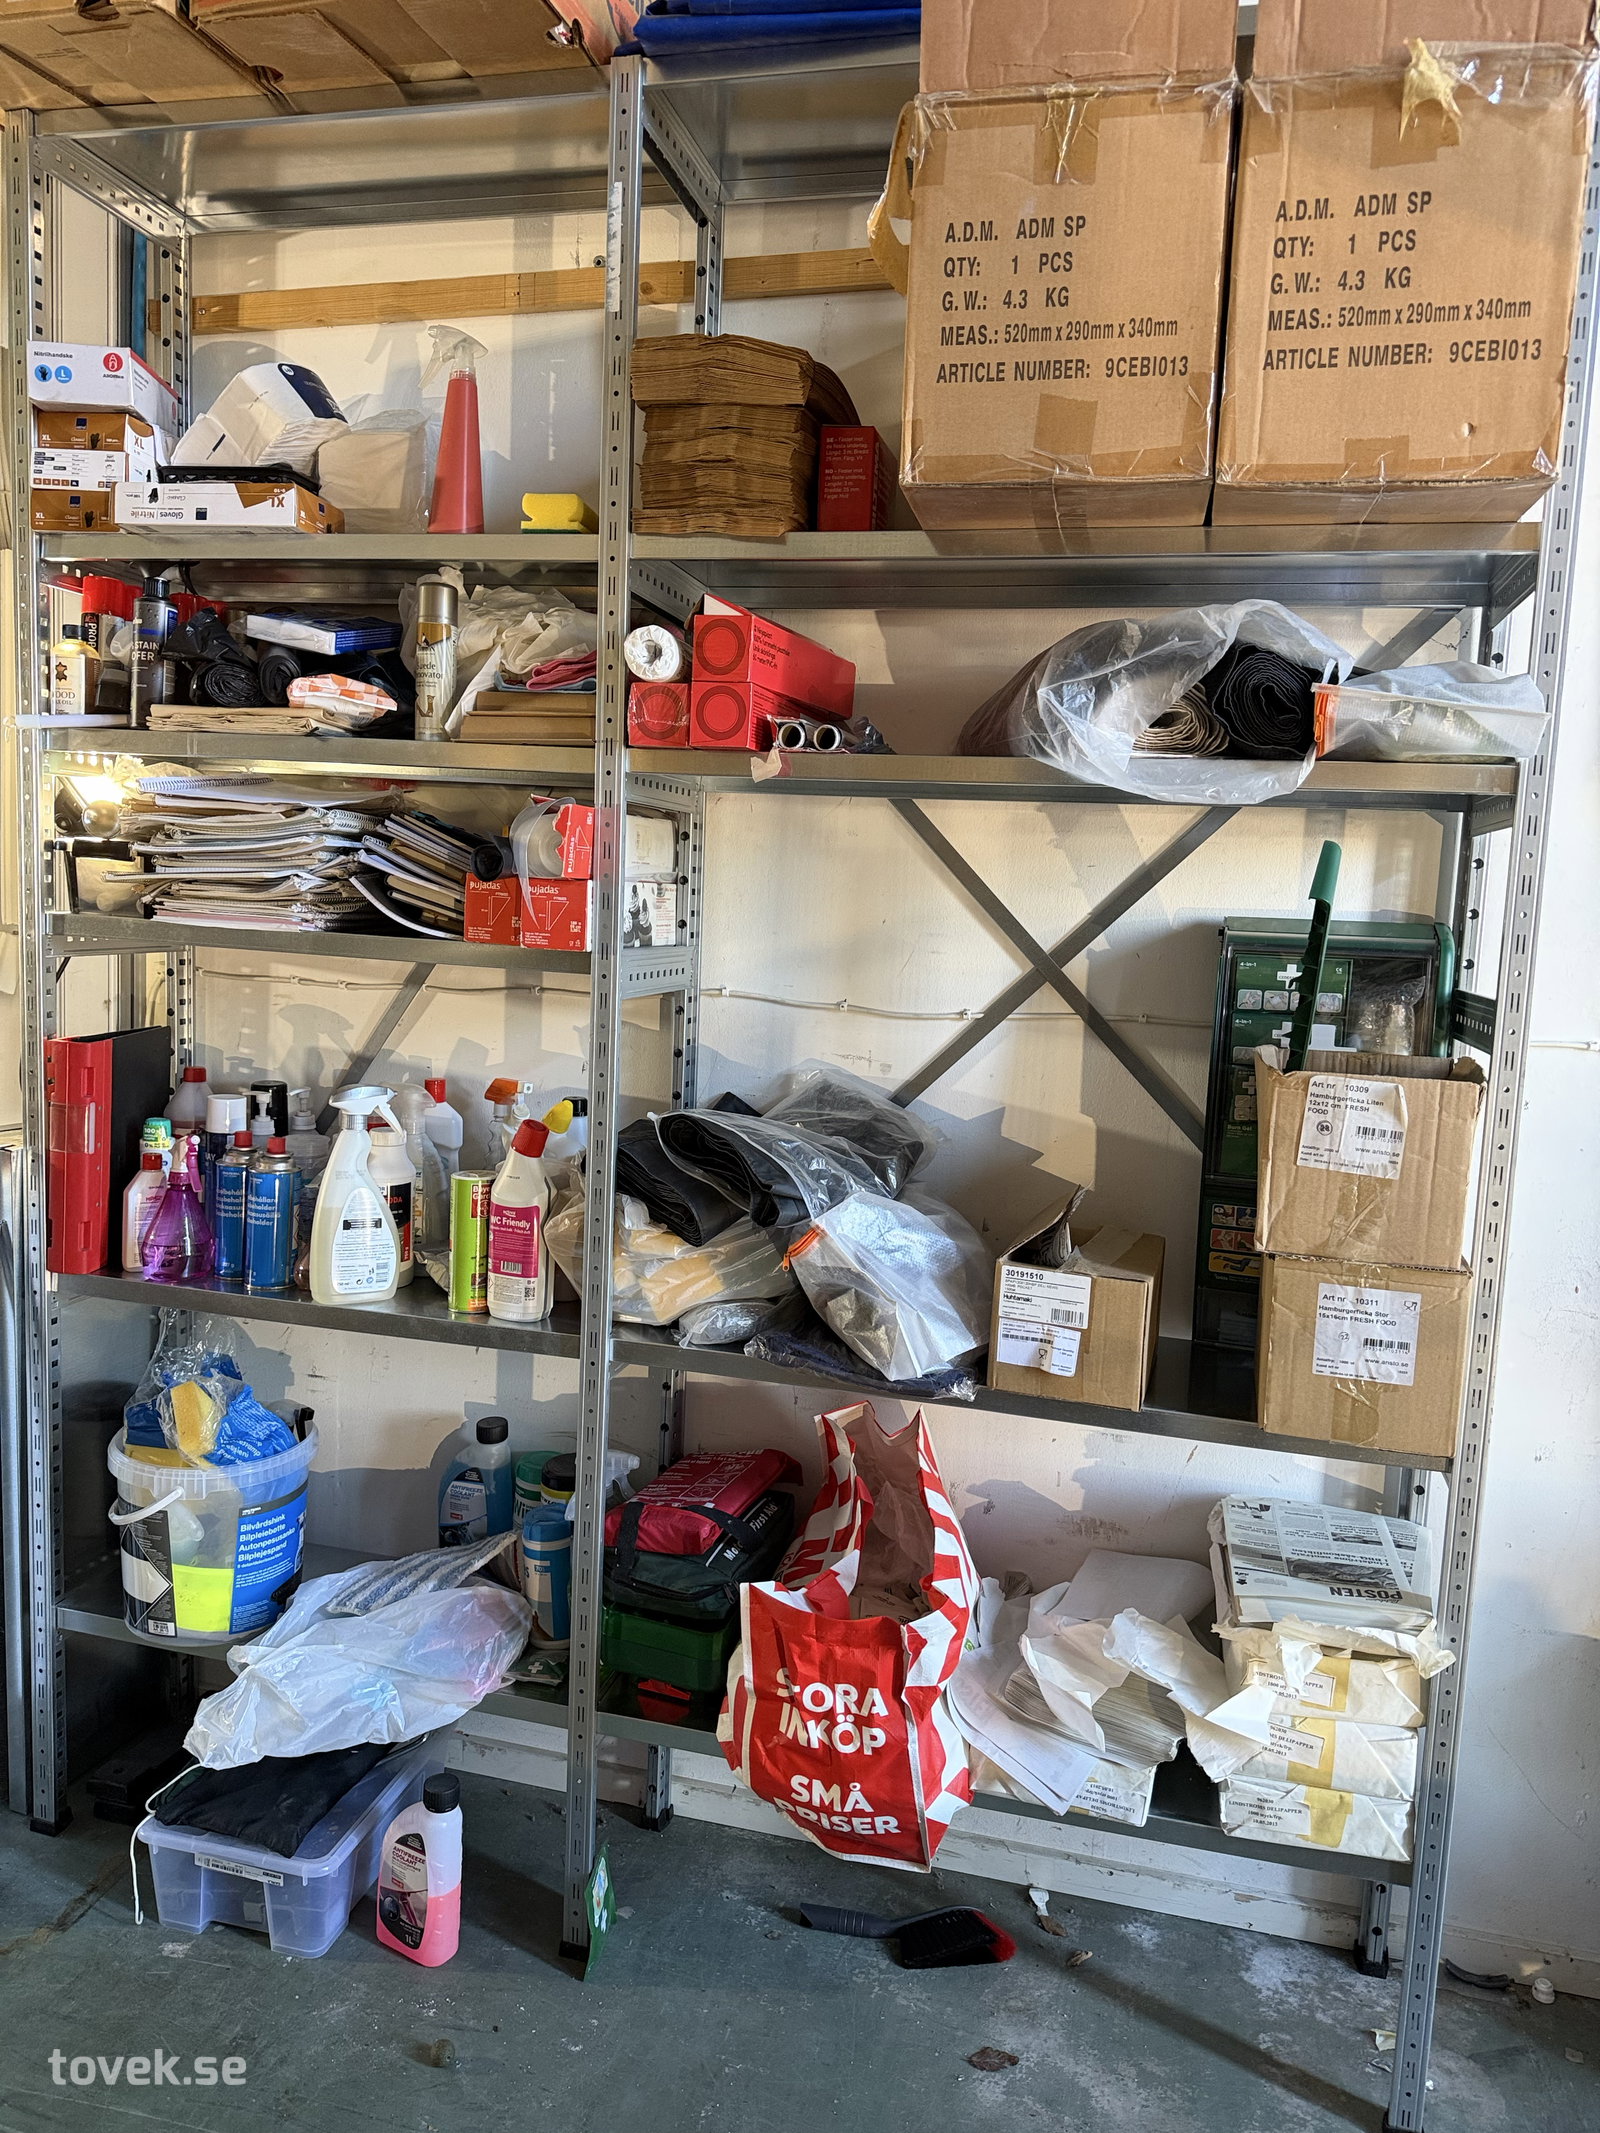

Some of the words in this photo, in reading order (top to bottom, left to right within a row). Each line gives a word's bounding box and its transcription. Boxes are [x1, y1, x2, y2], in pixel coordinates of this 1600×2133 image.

[1275, 197, 1335, 223] A.D.M.
[1353, 193, 1397, 217] ADM
[1407, 190, 1432, 214] SP
[945, 220, 998, 243] A.D.M.
[1016, 217, 1055, 240] ADM
[1063, 215, 1087, 237] SP
[1273, 235, 1314, 259] QTY:
[1348, 233, 1356, 255] 1
[1377, 228, 1417, 252] PCS
[943, 256, 981, 278] QTY:
[1011, 255, 1018, 275] 1
[1038, 251, 1073, 274] PCS
[1337, 269, 1365, 291] 4.3
[1384, 266, 1412, 289] KG
[1003, 289, 1028, 310] 4.3
[1045, 286, 1070, 308] KG
[1268, 307, 1332, 332] MEAS.:
[1338, 305, 1390, 328] 520mm
[1394, 308, 1403, 324] x
[1406, 301, 1460, 324] 290mm
[1463, 304, 1472, 321] x
[1475, 297, 1531, 320] 340mm
[940, 324, 998, 346] MEAS.:
[1004, 323, 1051, 343] 520mm
[1055, 327, 1062, 341] x
[1066, 319, 1114, 341] 290mm
[1118, 323, 1125, 338] x
[1128, 316, 1178, 338] 340mm
[33, 351, 74, 359] Nitrilhandske
[1263, 346, 1339, 370] ARTICLE
[1348, 343, 1432, 367] NUMBER:
[1449, 338, 1542, 363] 9CEBI013
[936, 361, 1005, 384] ARTICLE
[1013, 358, 1090, 382] NUMBER:
[1105, 355, 1189, 378] 9CEBI013
[134, 436, 145, 449] XL
[268, 496, 285, 508] XL
[130, 510, 155, 519] Nitrile
[159, 510, 184, 519] Gloves
[567, 837, 575, 873] pujadas
[470, 880, 501, 891] pujadas
[1312, 1080, 1324, 1089] Art
[1345, 1085, 1369, 1093] 10309
[1309, 1092, 1364, 1104] Hamburgerficka
[1308, 1107, 1328, 1115] FOOD
[1345, 1104, 1369, 1112] FRESH
[502, 1218, 531, 1231] Friendly
[1005, 1269, 1044, 1280] 30191510
[1003, 1294, 1032, 1302] Huhtamaki
[1355, 1298, 1378, 1306] 10311
[1319, 1305, 1372, 1317] Hamburgerficka
[1350, 1316, 1374, 1324] FRESH
[240, 1513, 285, 1532] Bilvårdshink
[749, 1513, 769, 1532] First
[766, 1502, 778, 1517] Aid
[238, 1527, 295, 1552] Autonpesusanko
[239, 1523, 286, 1542] Bilpleiebøtte
[238, 1540, 287, 1561] Bilplejespand
[1329, 1586, 1403, 1600] POSTEN
[778, 1702, 887, 1755] INKÖP
[1278, 1735, 1314, 1749] DELIPAPPER
[790, 1774, 875, 1813] SMÅ
[1099, 1799, 1136, 1814] LINDSTROMS
[1228, 1801, 1266, 1811] LINDSTROMS
[1267, 1806, 1302, 1814] DELIPAPPER
[392, 1850, 417, 1867] COOLANT
[393, 1846, 426, 1865] ANTIFREEZE
[404, 1934, 414, 1945] 1L
